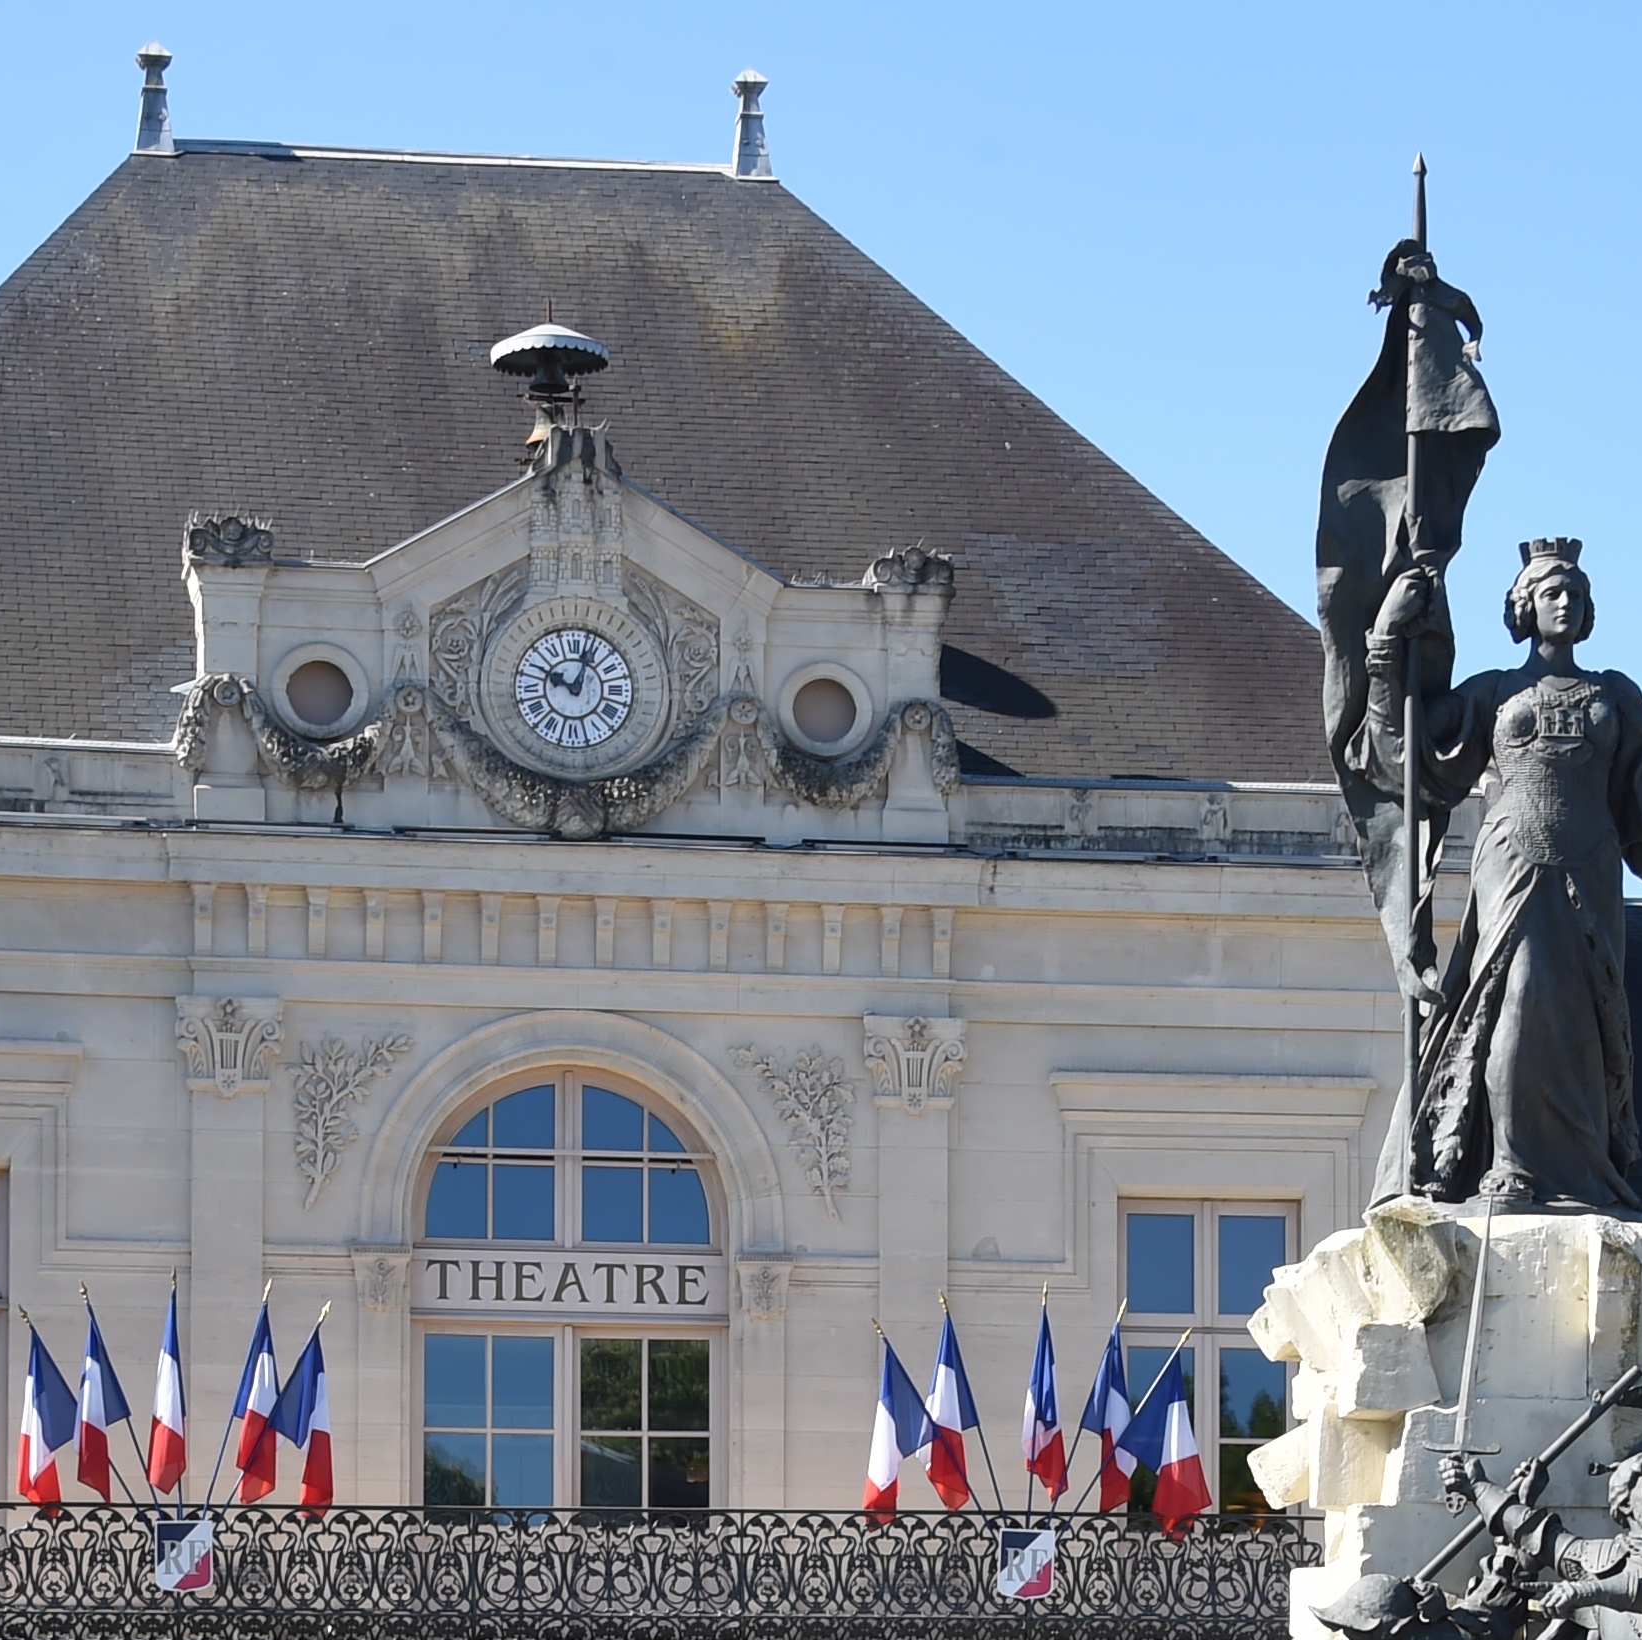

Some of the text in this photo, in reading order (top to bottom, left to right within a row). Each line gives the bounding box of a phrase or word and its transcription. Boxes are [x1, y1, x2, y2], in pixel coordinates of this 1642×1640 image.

[425, 1258, 711, 1306] THEATRE
[161, 1540, 207, 1575] RF
[1005, 1547, 1049, 1583] RF
